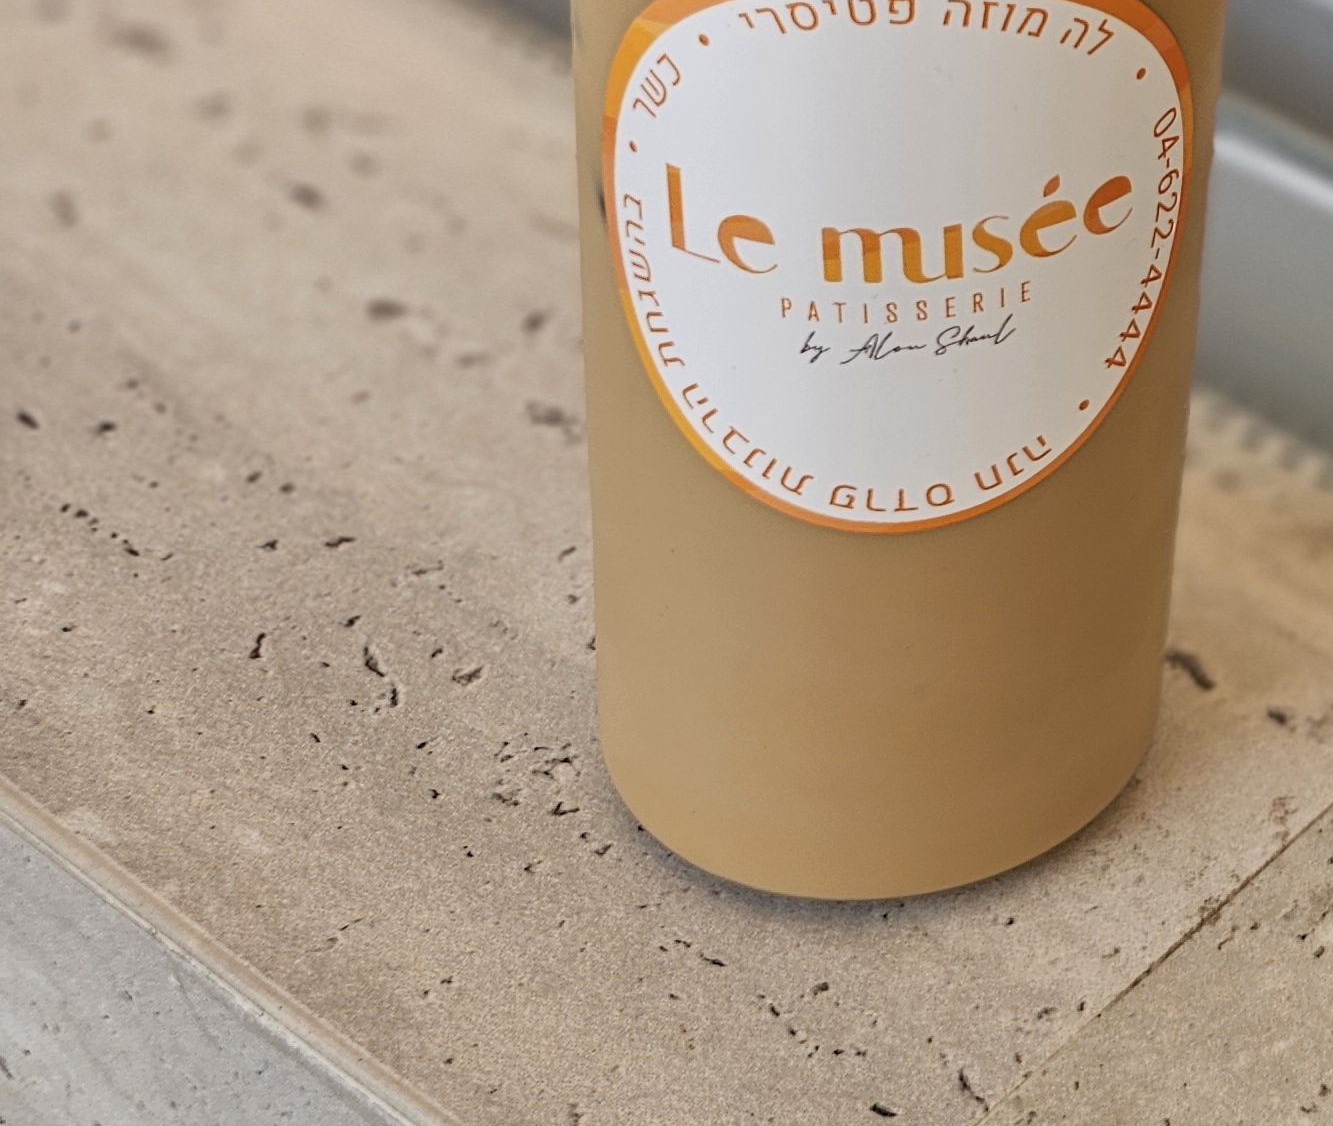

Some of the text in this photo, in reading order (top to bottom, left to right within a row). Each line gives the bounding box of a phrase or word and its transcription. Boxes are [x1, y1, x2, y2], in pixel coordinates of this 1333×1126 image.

[1059, 17, 1114, 57] לה
[632, 52, 683, 121] כשר
[665, 162, 1134, 285] Le musée
[1104, 106, 1179, 371] 04-622-4444
[780, 280, 1032, 324] PATISSERIE
[623, 193, 1053, 513] בהשגחת הרבנות פרדס חנה
[799, 330, 832, 364] by
